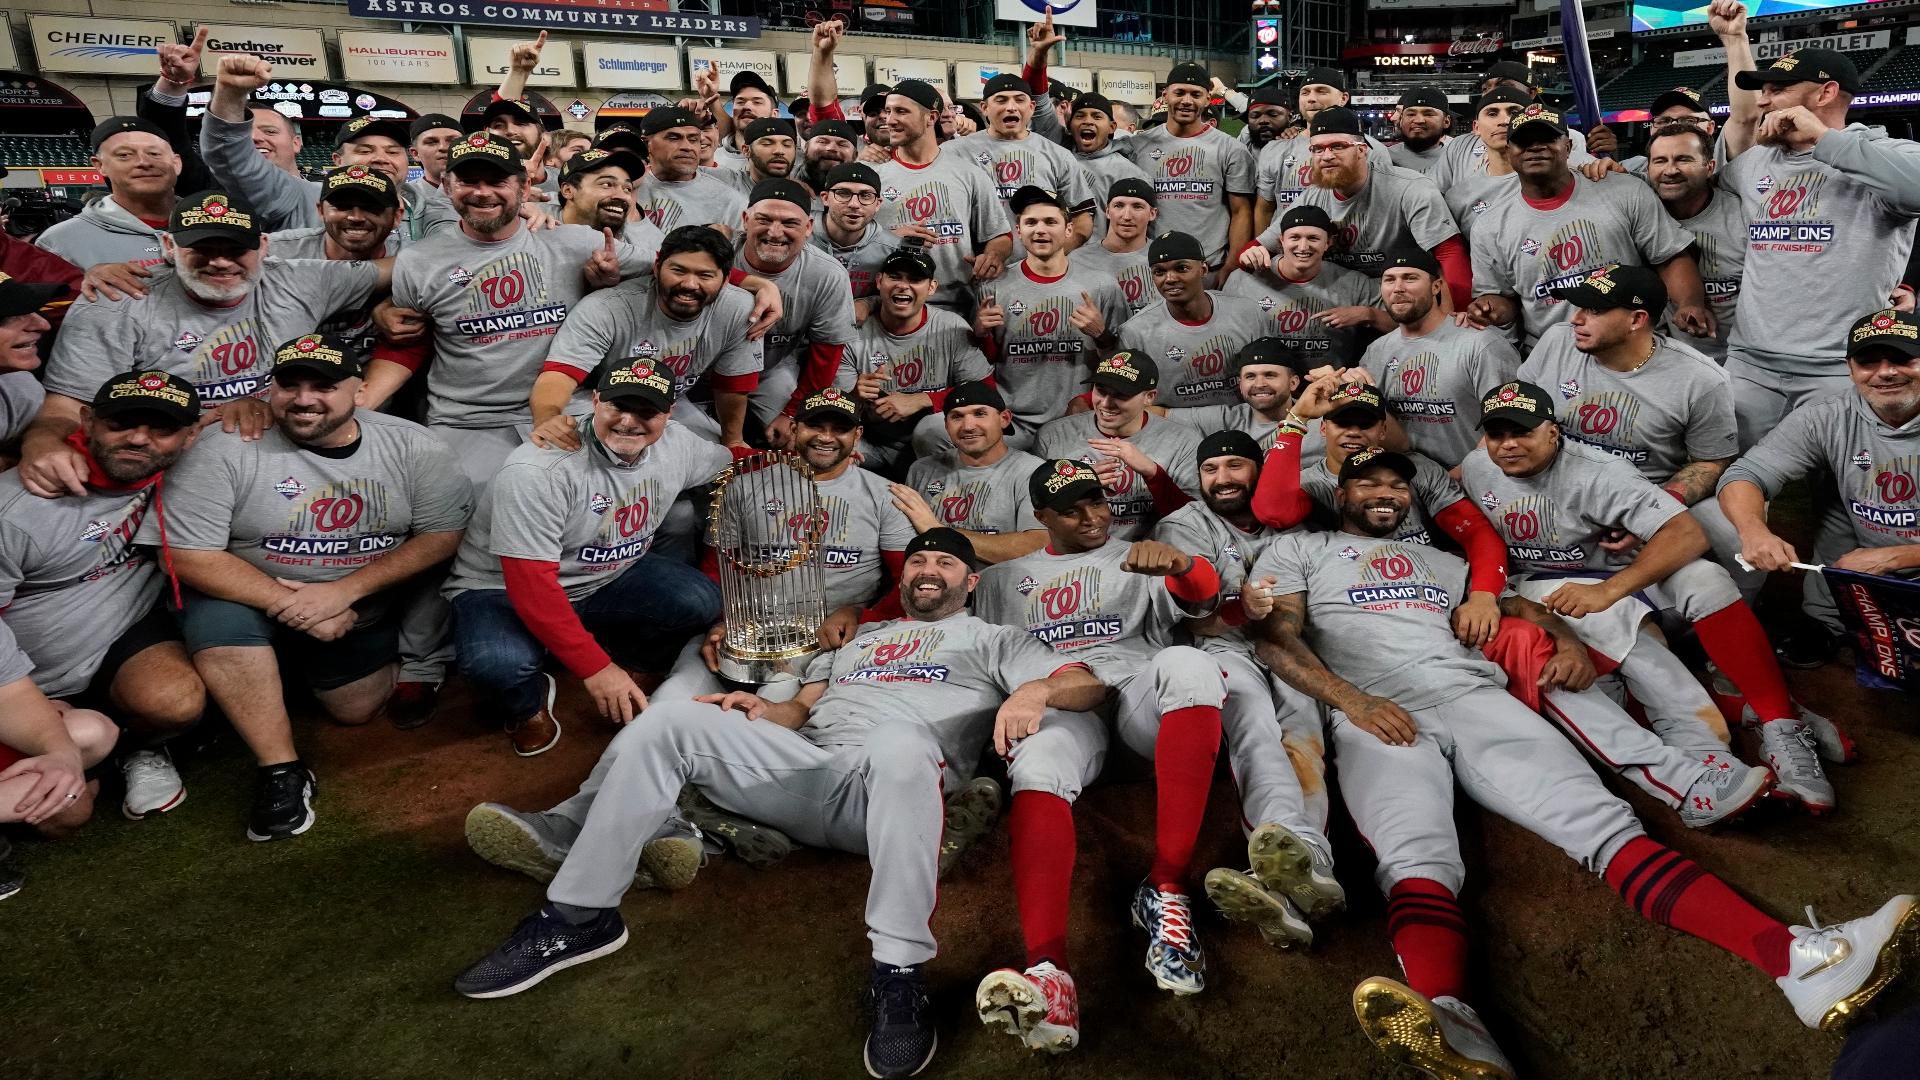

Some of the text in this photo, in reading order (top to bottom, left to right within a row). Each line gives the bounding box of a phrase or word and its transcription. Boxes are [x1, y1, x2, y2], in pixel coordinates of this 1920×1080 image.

[483, 5, 640, 29] COMMUNITY
[651, 15, 748, 33] LEADERS
[206, 38, 284, 53] Gardner
[348, 47, 448, 57] HALLIBURTON
[486, 65, 561, 76] LEUS
[598, 57, 668, 74] Schlumberger
[716, 60, 772, 71] HAMPION
[608, 101, 649, 109] Crawford
[452, 147, 510, 160] CHAMPIONS
[1166, 155, 1193, 178] W
[329, 177, 387, 192] CHAMPIONS
[1154, 182, 1213, 192] HAMPIONS
[905, 192, 937, 222] W
[1768, 186, 1807, 219] W
[181, 216, 251, 229] CHAMPIONS
[1549, 235, 1583, 271] W
[1771, 244, 1823, 253] FINISHED
[449, 270, 473, 279] WORLD
[481, 269, 524, 309] W
[1029, 307, 1060, 337] W
[1277, 307, 1309, 334] W
[1853, 328, 1918, 343] CHAMPIONS
[1854, 326, 1877, 335] WORLD
[211, 335, 257, 376] W
[276, 351, 342, 365] CHAMPIONS
[1192, 348, 1224, 377] W
[893, 357, 923, 388] W
[1096, 365, 1138, 382] CHAMPIONS
[1402, 365, 1425, 397] W
[609, 376, 669, 394] CHAMPIONS
[1560, 382, 1582, 393] WORLD
[109, 387, 189, 407] CHAMPIONS
[805, 400, 856, 414] CHAMPIONS
[1484, 401, 1536, 414] CHAMPIONS
[1578, 404, 1618, 435] W
[1048, 475, 1097, 494] CHAMPIONS
[1875, 471, 1917, 504] W
[310, 493, 364, 532] W
[614, 496, 649, 538] W
[942, 492, 975, 524] W
[1504, 509, 1538, 541] W
[265, 553, 316, 566] FIGHT
[1370, 553, 1414, 580] W
[1040, 580, 1082, 620] W
